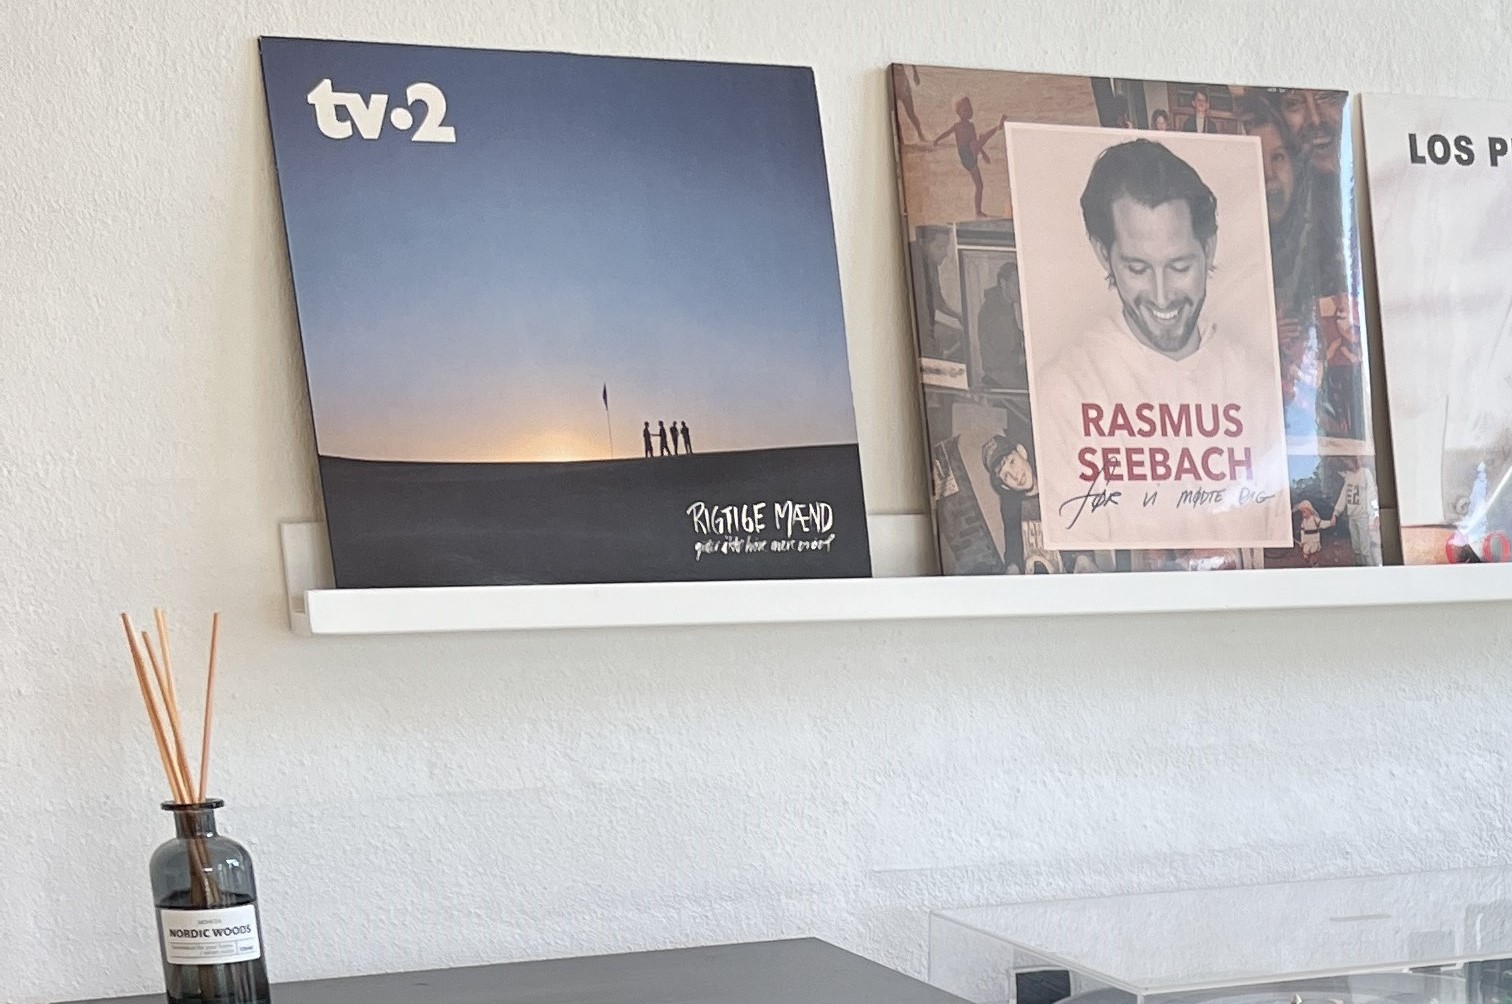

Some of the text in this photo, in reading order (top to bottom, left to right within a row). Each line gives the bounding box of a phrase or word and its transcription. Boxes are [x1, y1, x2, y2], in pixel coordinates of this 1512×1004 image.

[1408, 132, 1475, 167] LOS
[1081, 402, 1244, 438] RASMUS
[1077, 446, 1254, 482] SEEBACH
[686, 499, 834, 538] RIGTIGE MÆND
[168, 923, 252, 939] NORDIC WOODS
